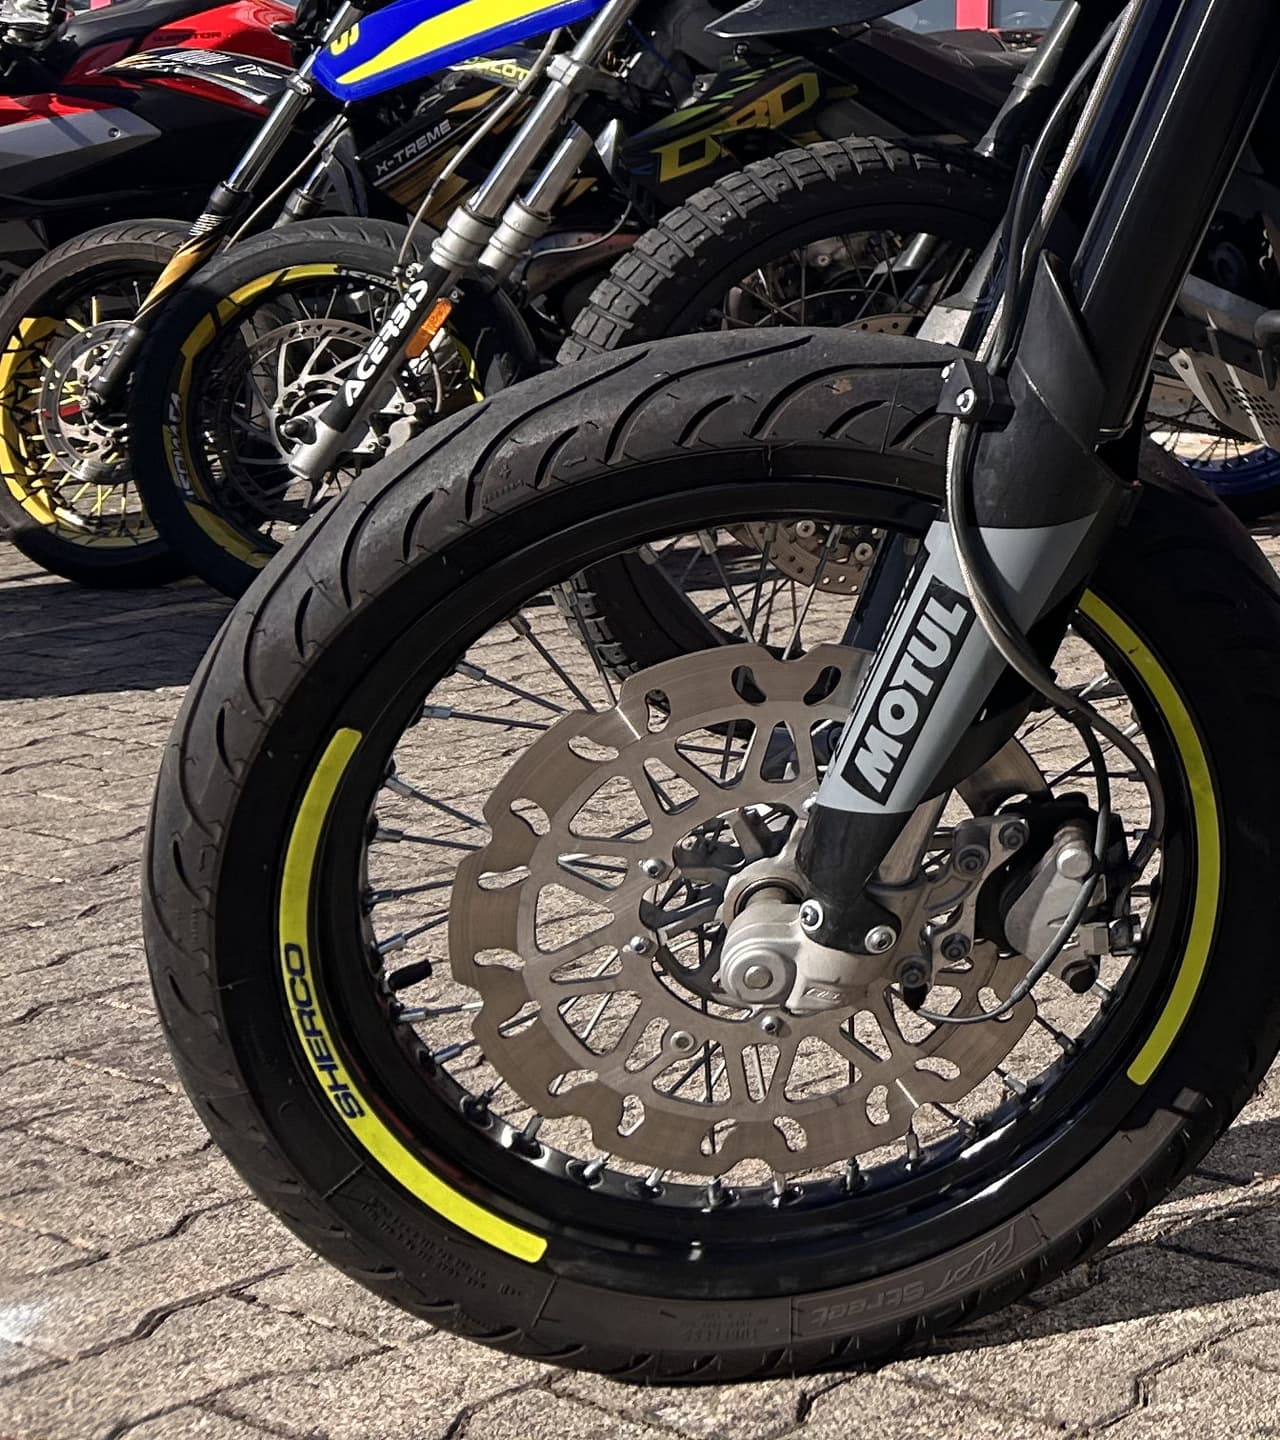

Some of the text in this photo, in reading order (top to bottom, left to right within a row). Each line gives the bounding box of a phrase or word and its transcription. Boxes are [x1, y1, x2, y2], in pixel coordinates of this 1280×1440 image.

[375, 118, 452, 177] X-TREME
[854, 596, 969, 793] MOTUL
[284, 942, 366, 1120] SHERCO
